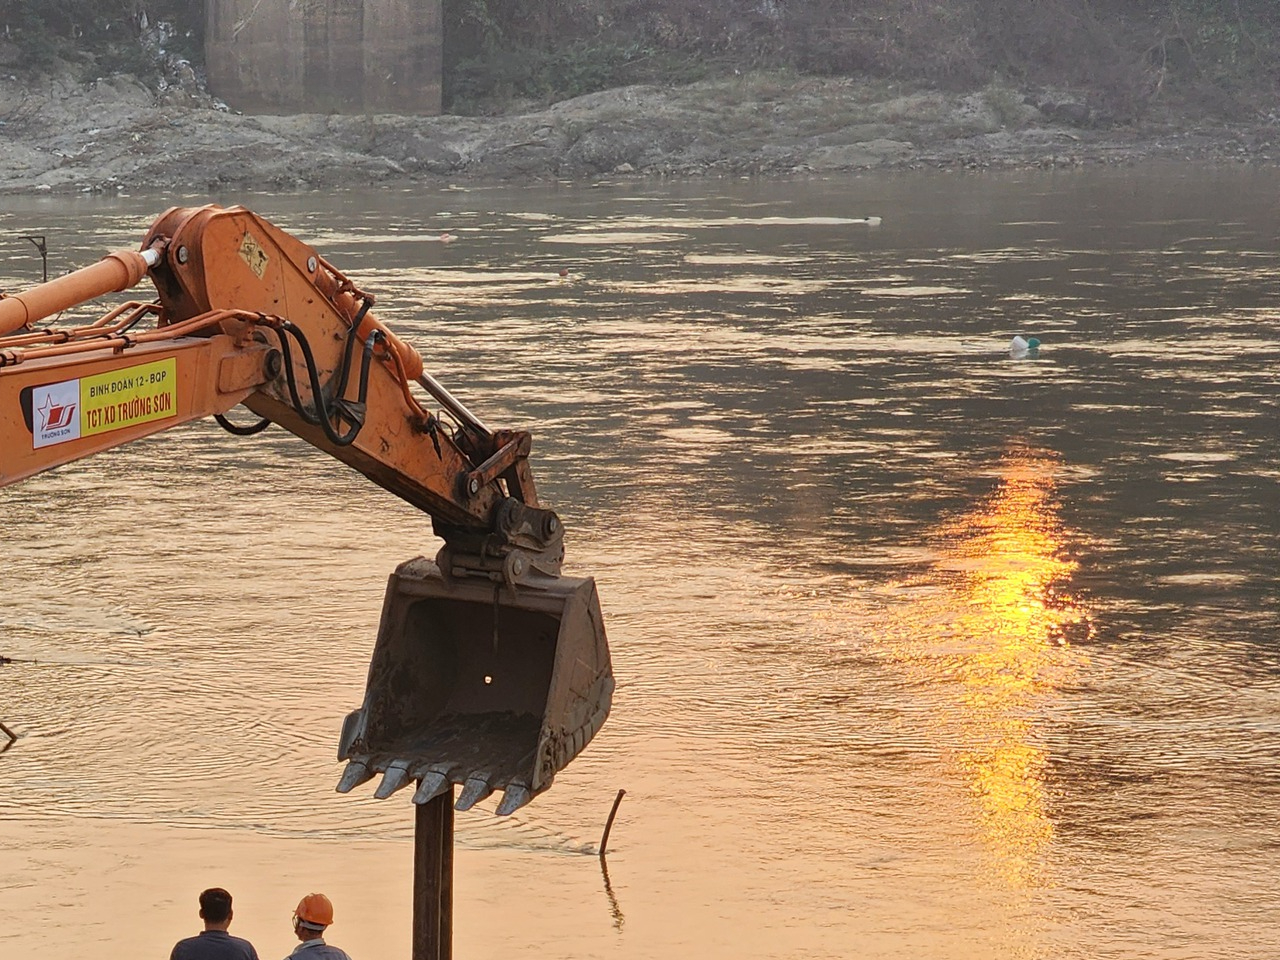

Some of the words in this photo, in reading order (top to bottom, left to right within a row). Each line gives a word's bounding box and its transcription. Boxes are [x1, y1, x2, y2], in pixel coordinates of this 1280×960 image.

[111, 377, 134, 393] ĐOÀN
[135, 376, 144, 388] 12
[150, 371, 167, 384] BQP
[87, 407, 102, 429] TCT
[104, 406, 116, 424] XD
[118, 395, 152, 421] TRƯỜNG
[154, 391, 171, 414] SƠN
